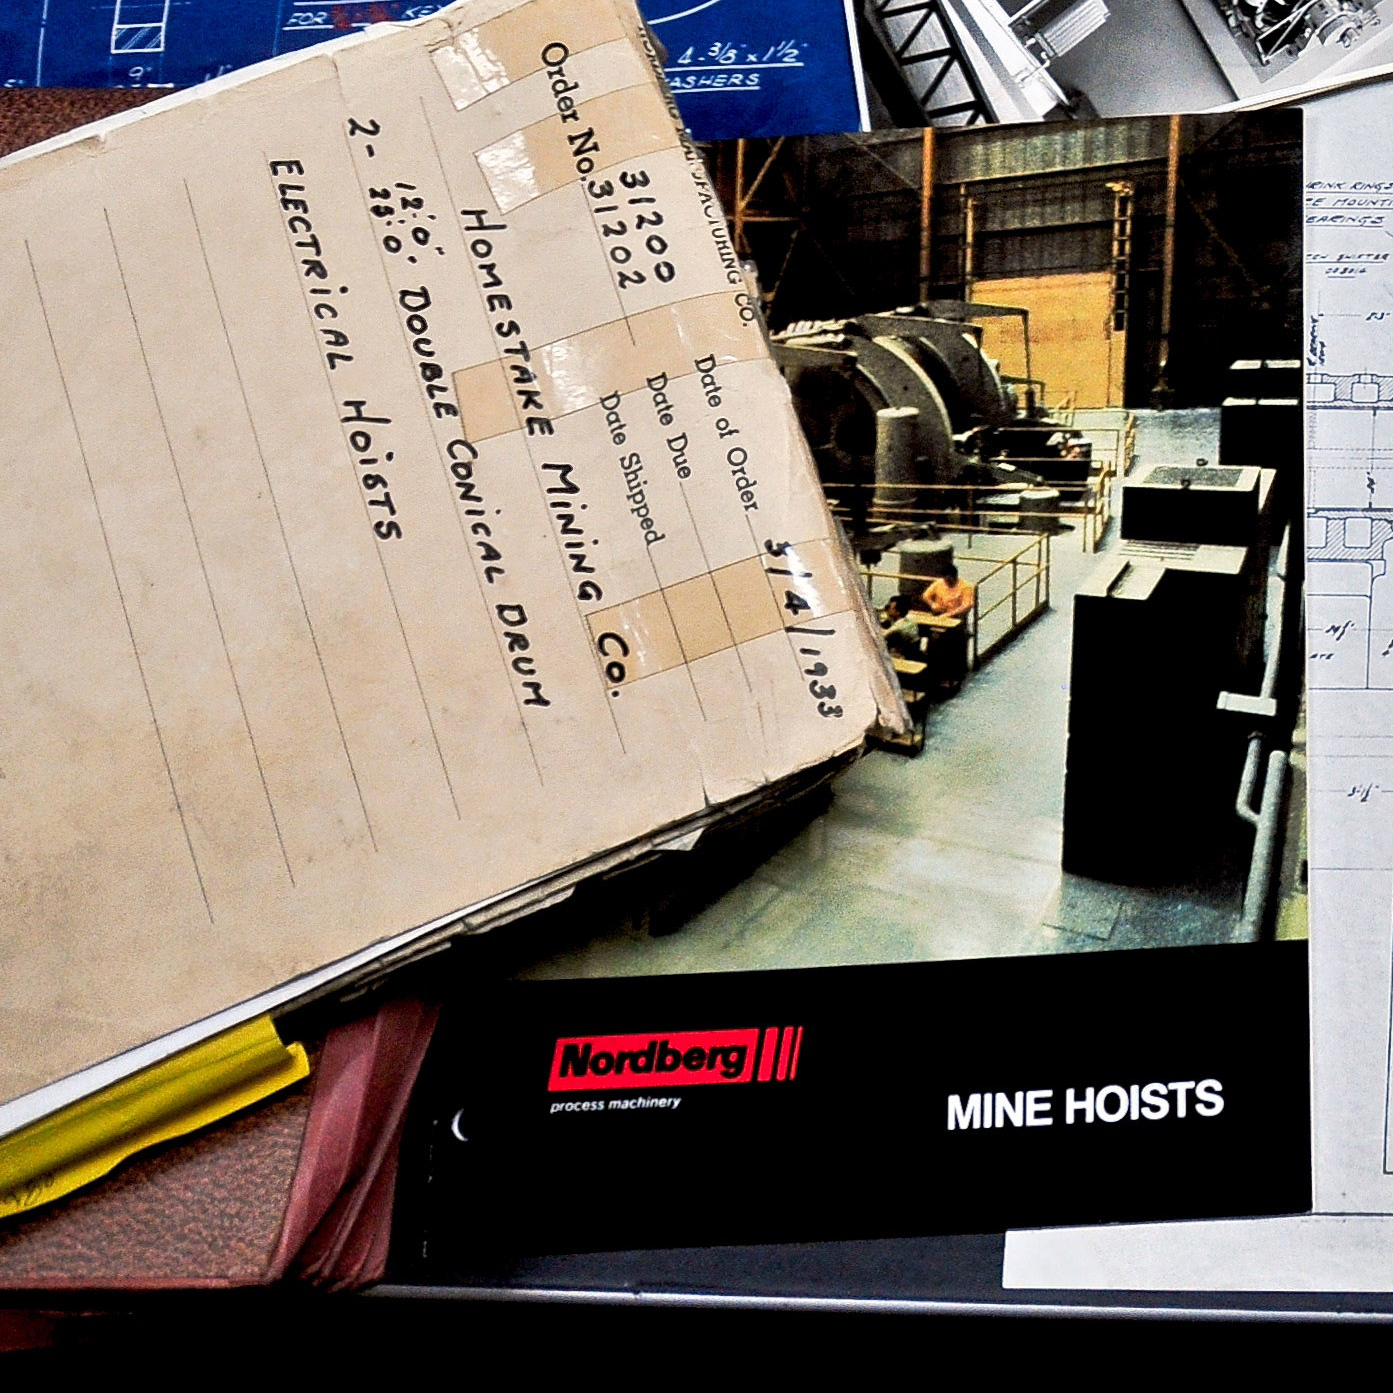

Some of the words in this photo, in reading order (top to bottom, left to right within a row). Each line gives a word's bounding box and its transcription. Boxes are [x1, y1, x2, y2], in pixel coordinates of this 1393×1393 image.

[286, 11, 328, 25] FOR
[541, 41, 580, 124] Order
[568, 127, 600, 182] No.
[587, 180, 647, 289] 31202
[619, 170, 676, 284] 31200
[461, 208, 555, 438] HOMESTAKE
[735, 292, 756, 328] CO.
[694, 354, 722, 408] Date
[646, 371, 674, 426] Date
[666, 432, 691, 479] Due
[715, 417, 740, 439] of
[399, 286, 458, 420] DOUBLE
[496, 602, 551, 708] DRUM
[600, 390, 627, 446] Date
[619, 452, 666, 546] Shipped
[727, 447, 759, 511] Order
[559, 1041, 748, 1080] Nordberg
[550, 1098, 605, 1114] process
[608, 1095, 682, 1111] machinery
[947, 1090, 1053, 1130] MINE
[1065, 1079, 1224, 1123] HOISTS
